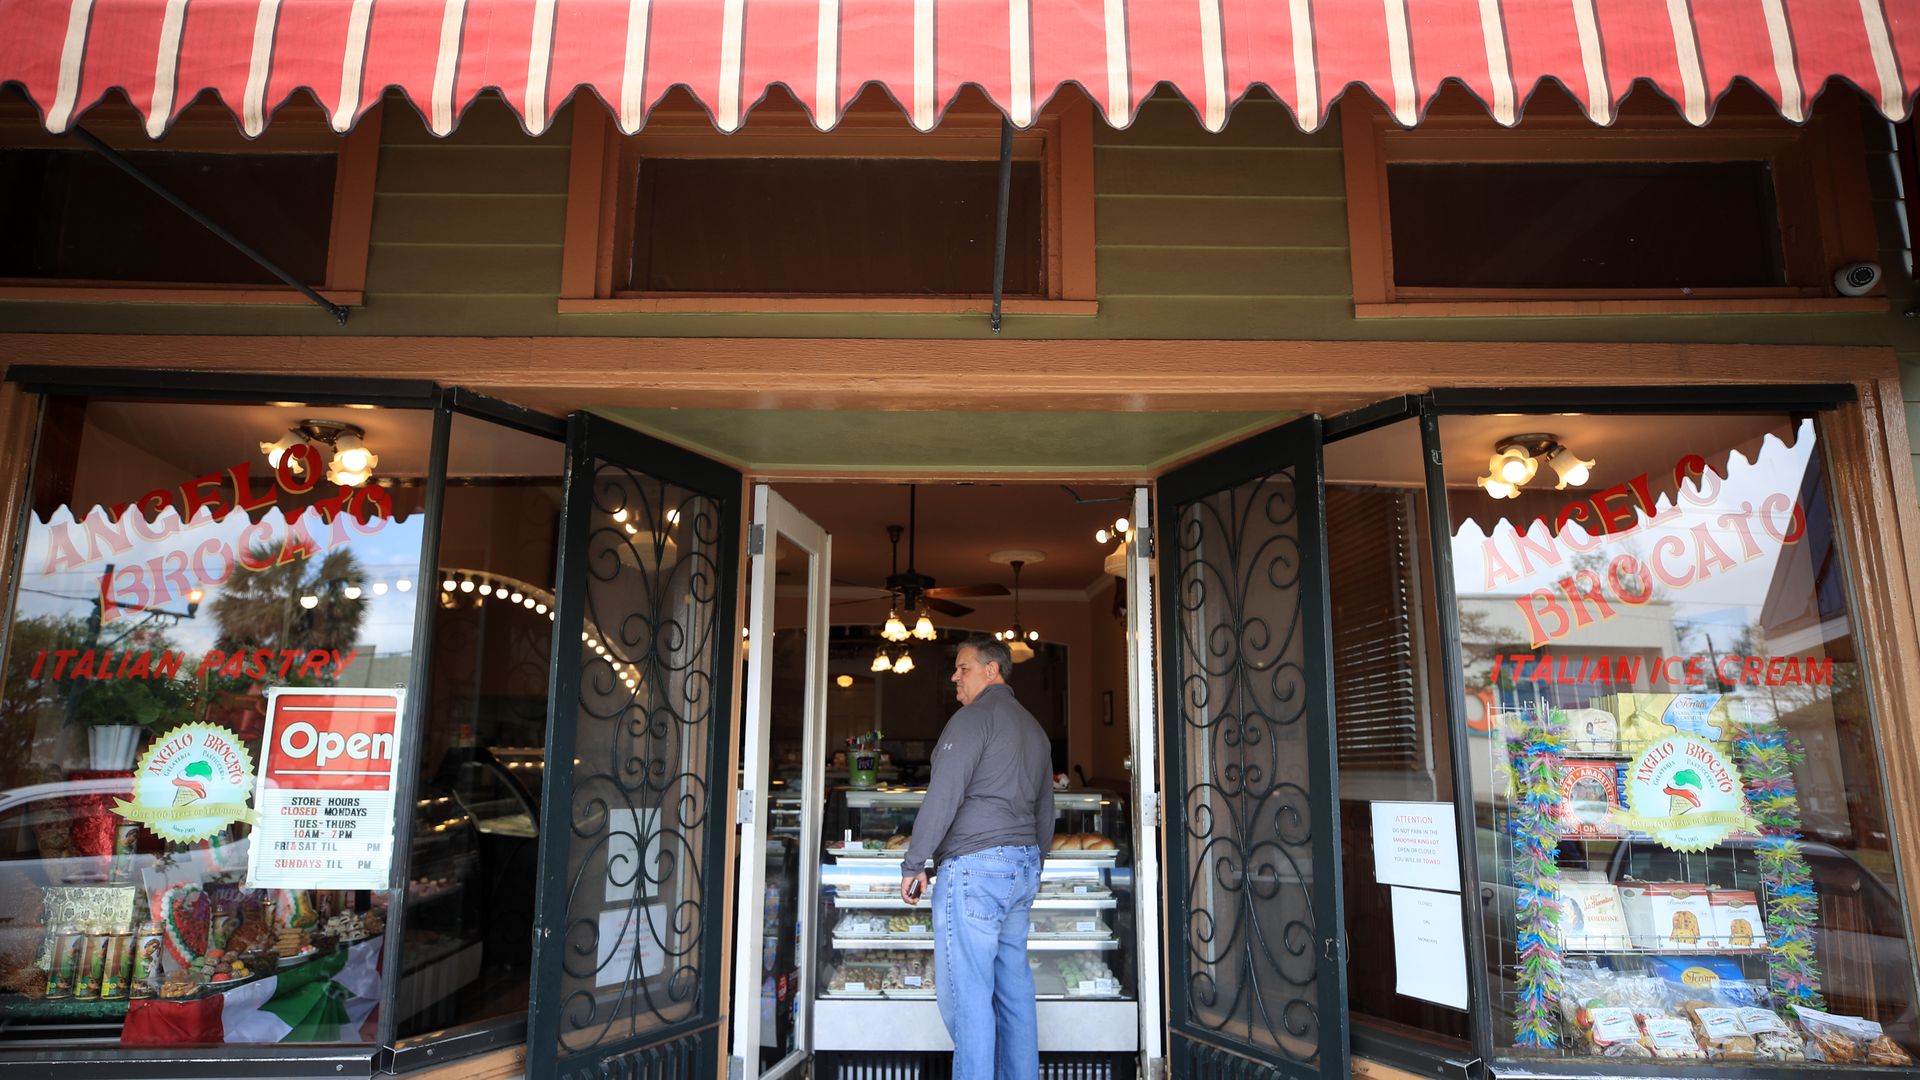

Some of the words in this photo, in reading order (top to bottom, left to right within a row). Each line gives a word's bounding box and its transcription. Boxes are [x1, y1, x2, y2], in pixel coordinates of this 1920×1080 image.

[41, 443, 323, 576] ANGELO
[1481, 453, 1722, 591] ANGELO
[97, 484, 393, 623] BROCATO
[1514, 492, 1806, 650] BROCATO
[30, 649, 185, 681] ITALIAN
[195, 648, 358, 679] PASTRY
[1490, 653, 1640, 685] ITALIAN
[1649, 655, 1704, 685] ICE
[1718, 655, 1834, 687] CREAM
[148, 733, 193, 776] ANGELO
[203, 733, 244, 784] BROCATO
[280, 721, 393, 767] Open
[1637, 742, 1674, 785] ANGELO
[1685, 742, 1733, 793] BROCATO
[280, 807, 317, 816] CLOSED
[324, 808, 367, 817] MONDAYS
[291, 797, 321, 806] STORE
[328, 797, 360, 807] HOURS
[1395, 815, 1433, 824] ATTENTION
[274, 859, 321, 869] SUNDAYS
[326, 860, 342, 869] TIL
[358, 860, 371, 869] PM
[322, 842, 338, 852] TIL
[367, 843, 380, 852] PM
